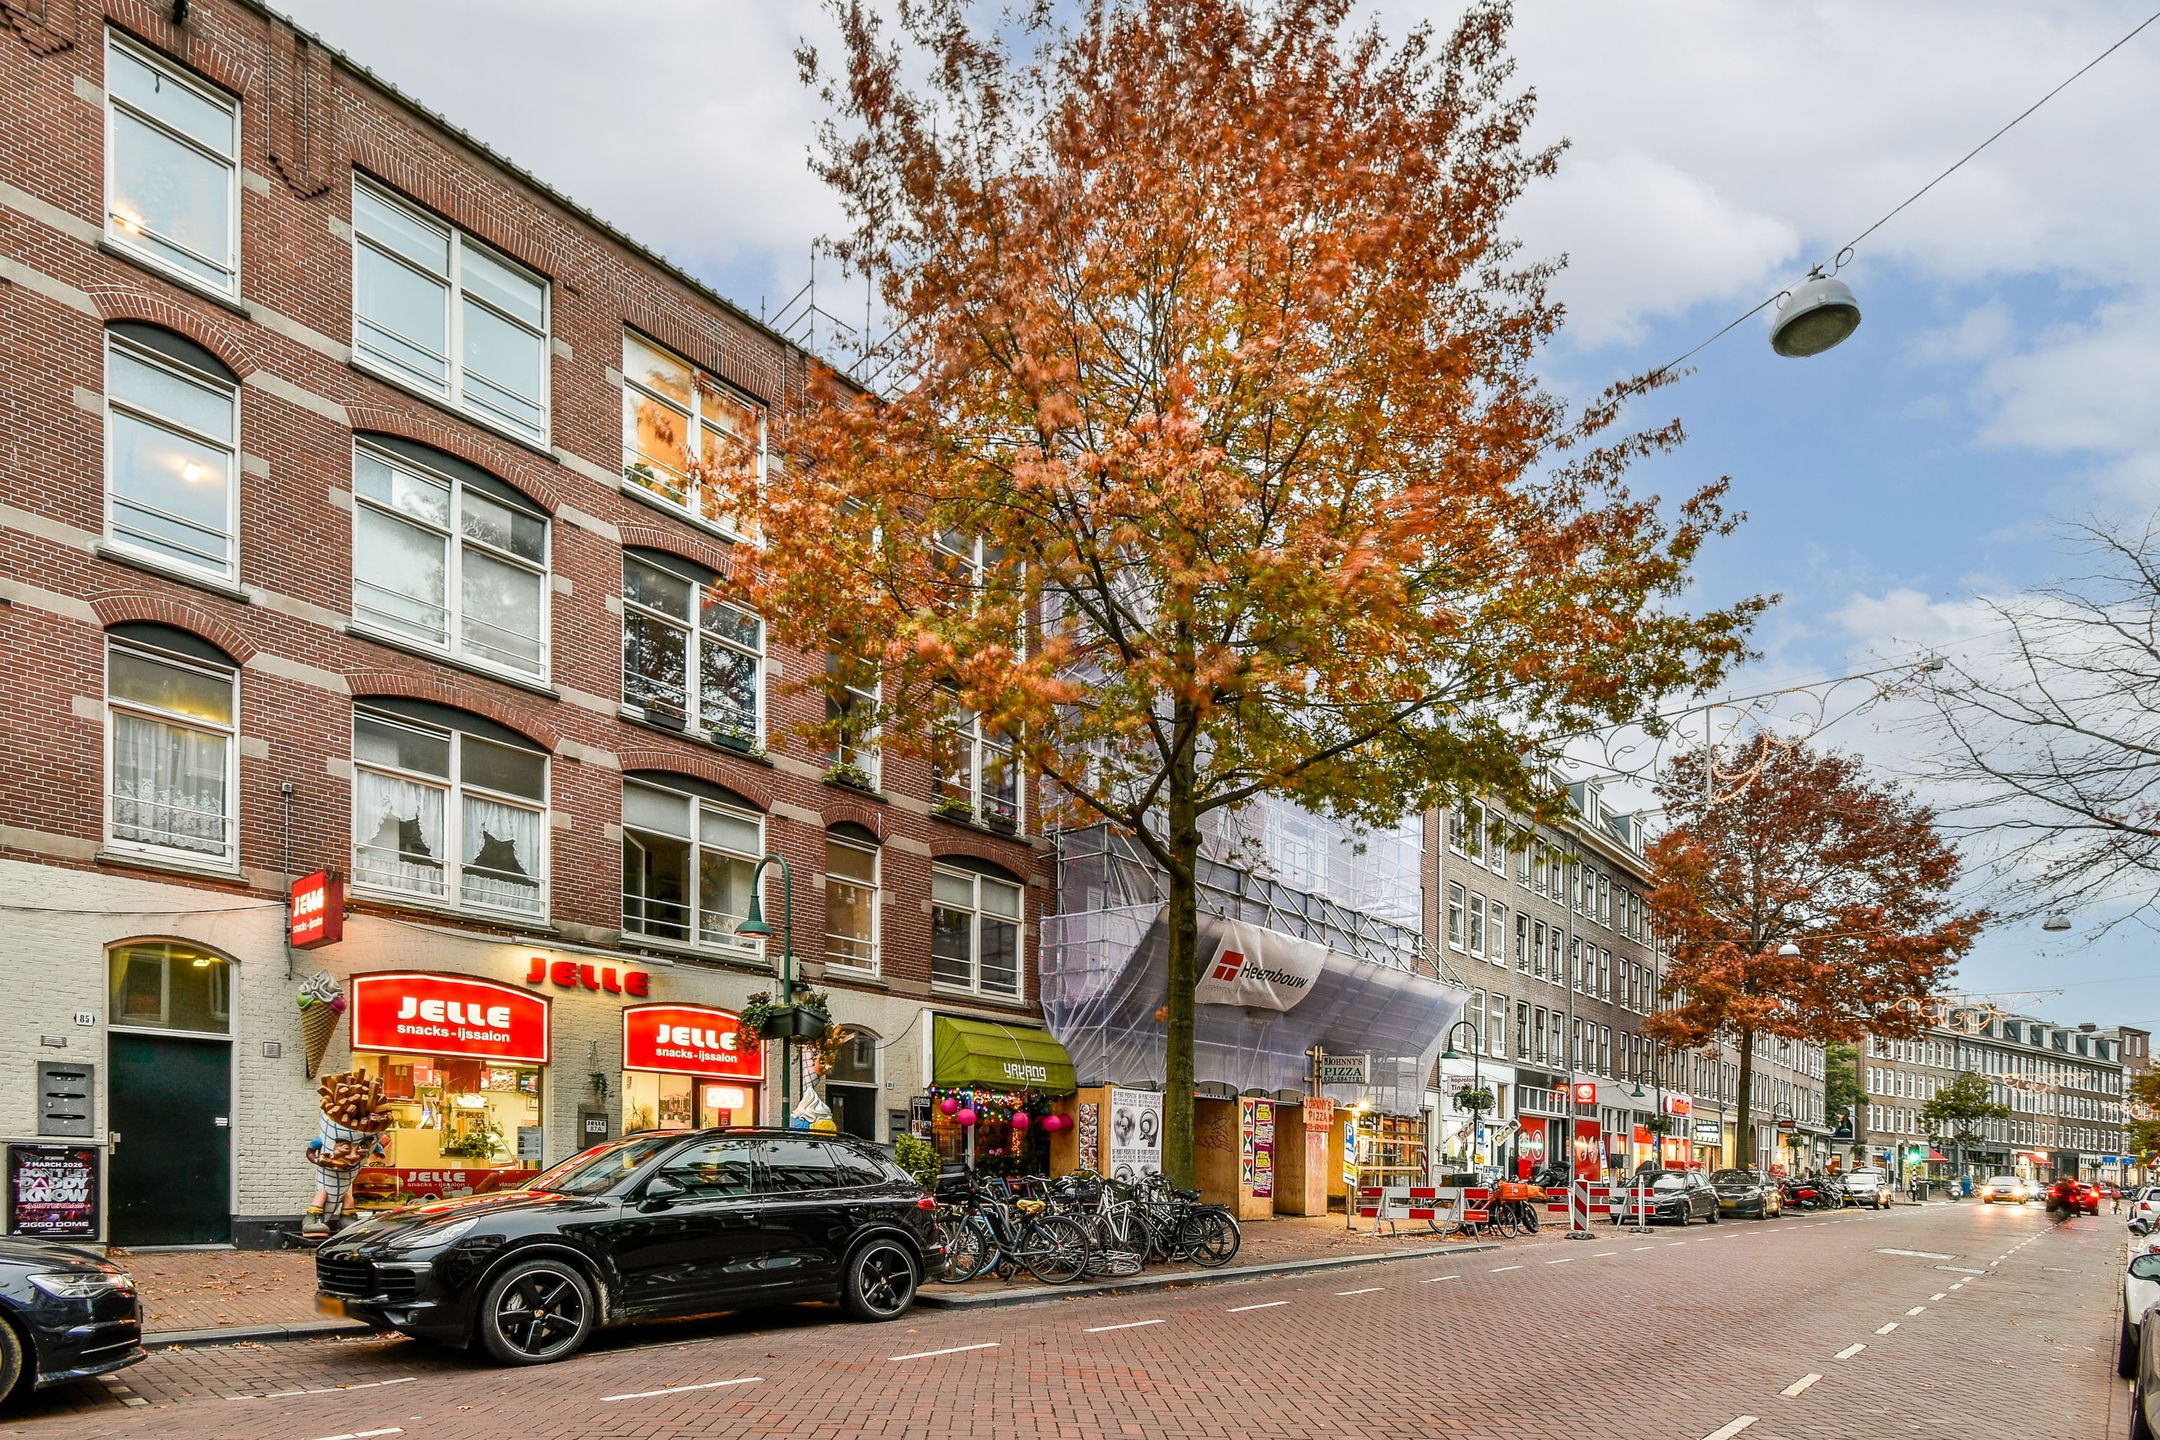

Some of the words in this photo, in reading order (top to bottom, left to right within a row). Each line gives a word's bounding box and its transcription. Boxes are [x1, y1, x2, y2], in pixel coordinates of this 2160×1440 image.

[294, 887, 324, 917] JELLE
[527, 957, 649, 996] JELLE
[1240, 962, 1309, 988] Heembouw
[79, 1014, 90, 1023] 85
[398, 997, 510, 1028] JELLE
[656, 1024, 738, 1050] JELLE
[1326, 1056, 1363, 1066] JOHNNY'S
[1323, 1067, 1362, 1076] PIZZA
[1308, 1110, 1328, 1123] PIZZA
[1346, 1125, 1353, 1140] P
[1478, 1123, 1484, 1136] P
[19, 1177, 89, 1189] DADDY
[407, 1172, 466, 1182] JELLE
[19, 1189, 89, 1202] KNOW
